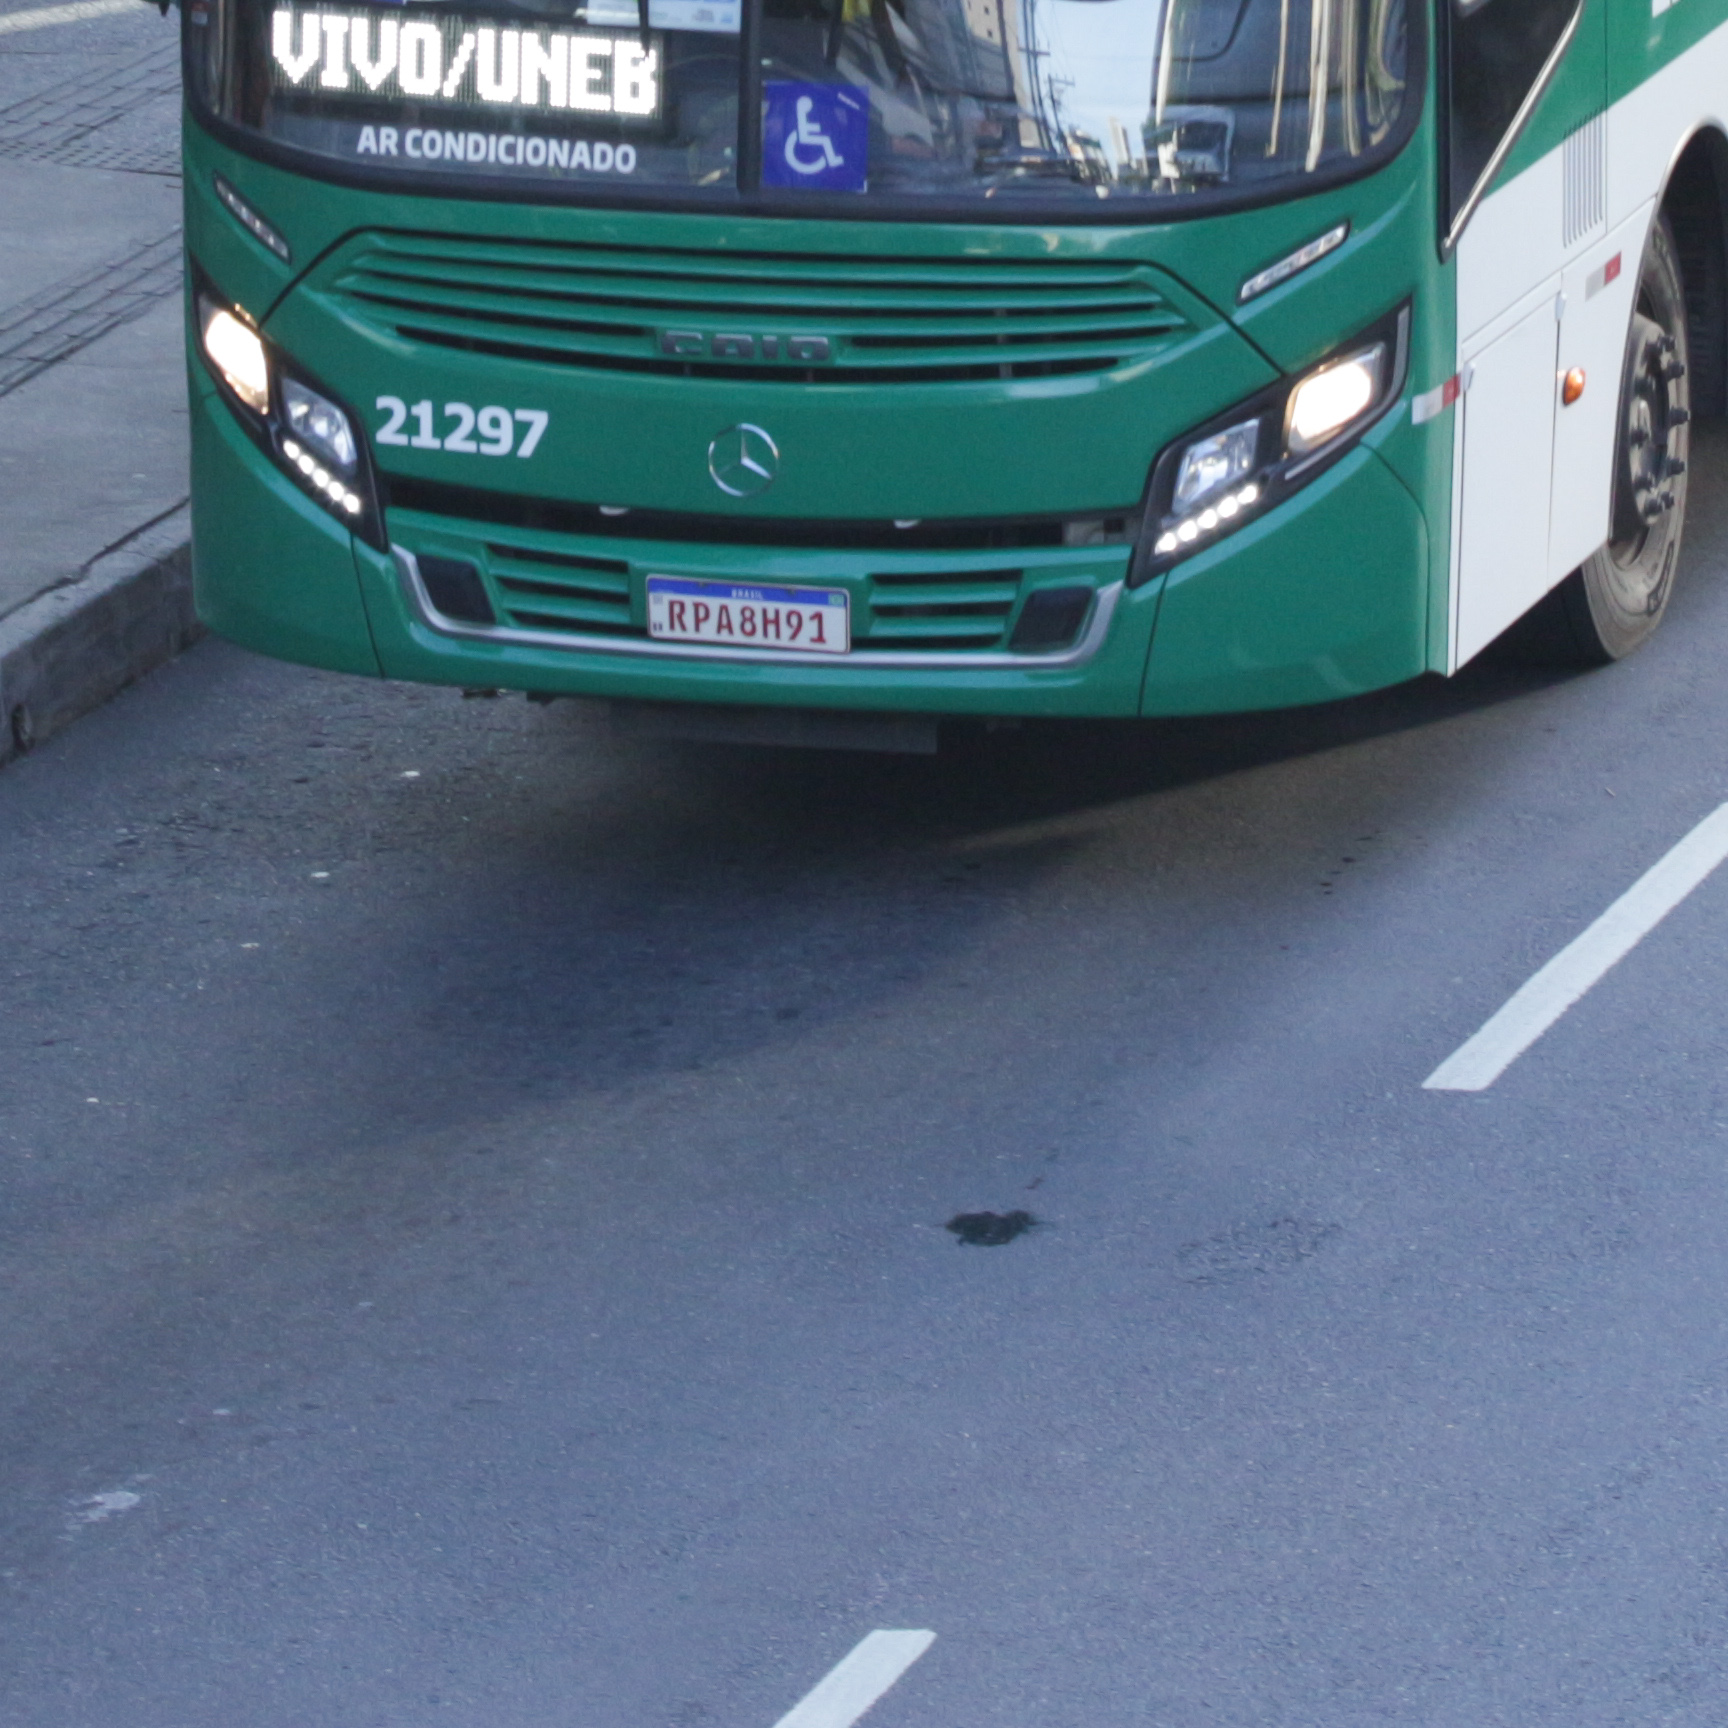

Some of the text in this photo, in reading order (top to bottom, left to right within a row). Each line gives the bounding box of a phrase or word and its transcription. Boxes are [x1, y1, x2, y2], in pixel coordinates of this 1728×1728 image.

[272, 10, 657, 115] VIVO/UNEB
[357, 126, 637, 174] AR CONDICIONADO
[661, 330, 830, 360] CAIO
[375, 395, 550, 459] 21297
[668, 599, 827, 644] RPA8H91
